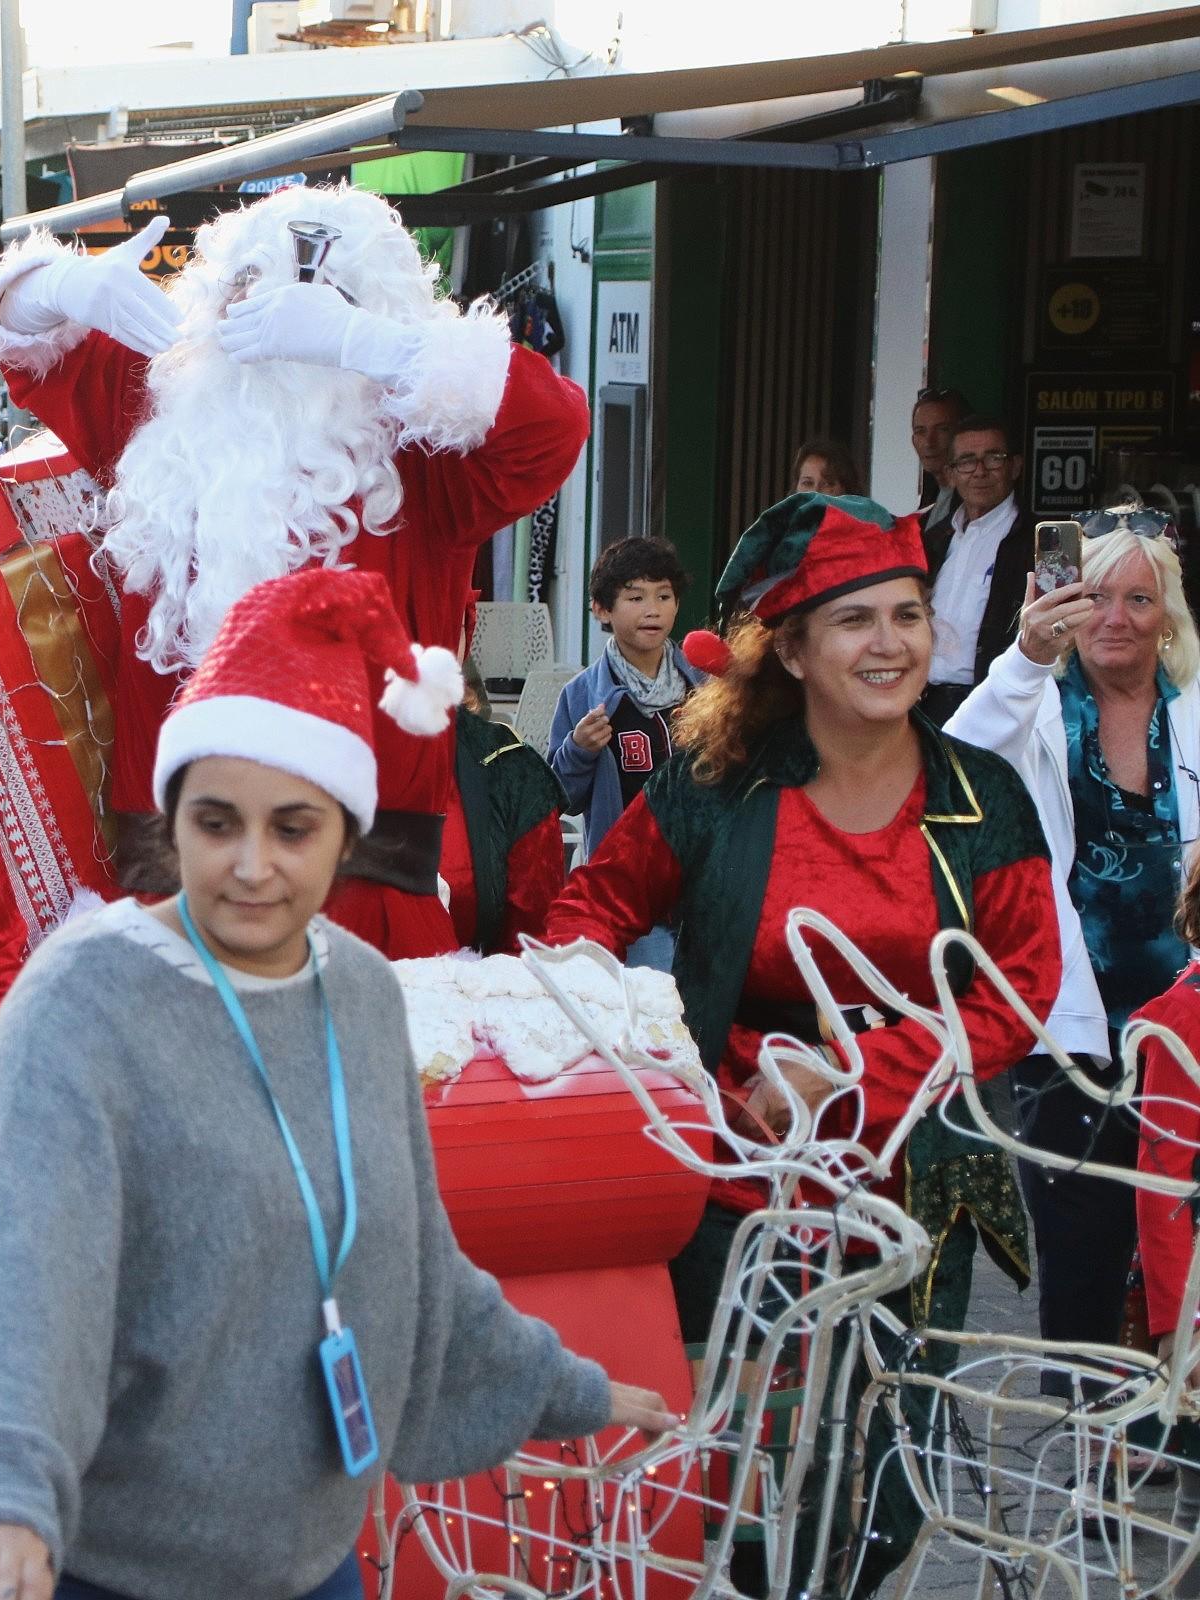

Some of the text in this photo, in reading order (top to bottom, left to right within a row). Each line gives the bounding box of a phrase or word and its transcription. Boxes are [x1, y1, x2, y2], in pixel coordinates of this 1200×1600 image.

[609, 312, 640, 353] ATM
[1102, 390, 1145, 410] TIPO
[1041, 455, 1086, 491] 60
[618, 730, 653, 771] B
